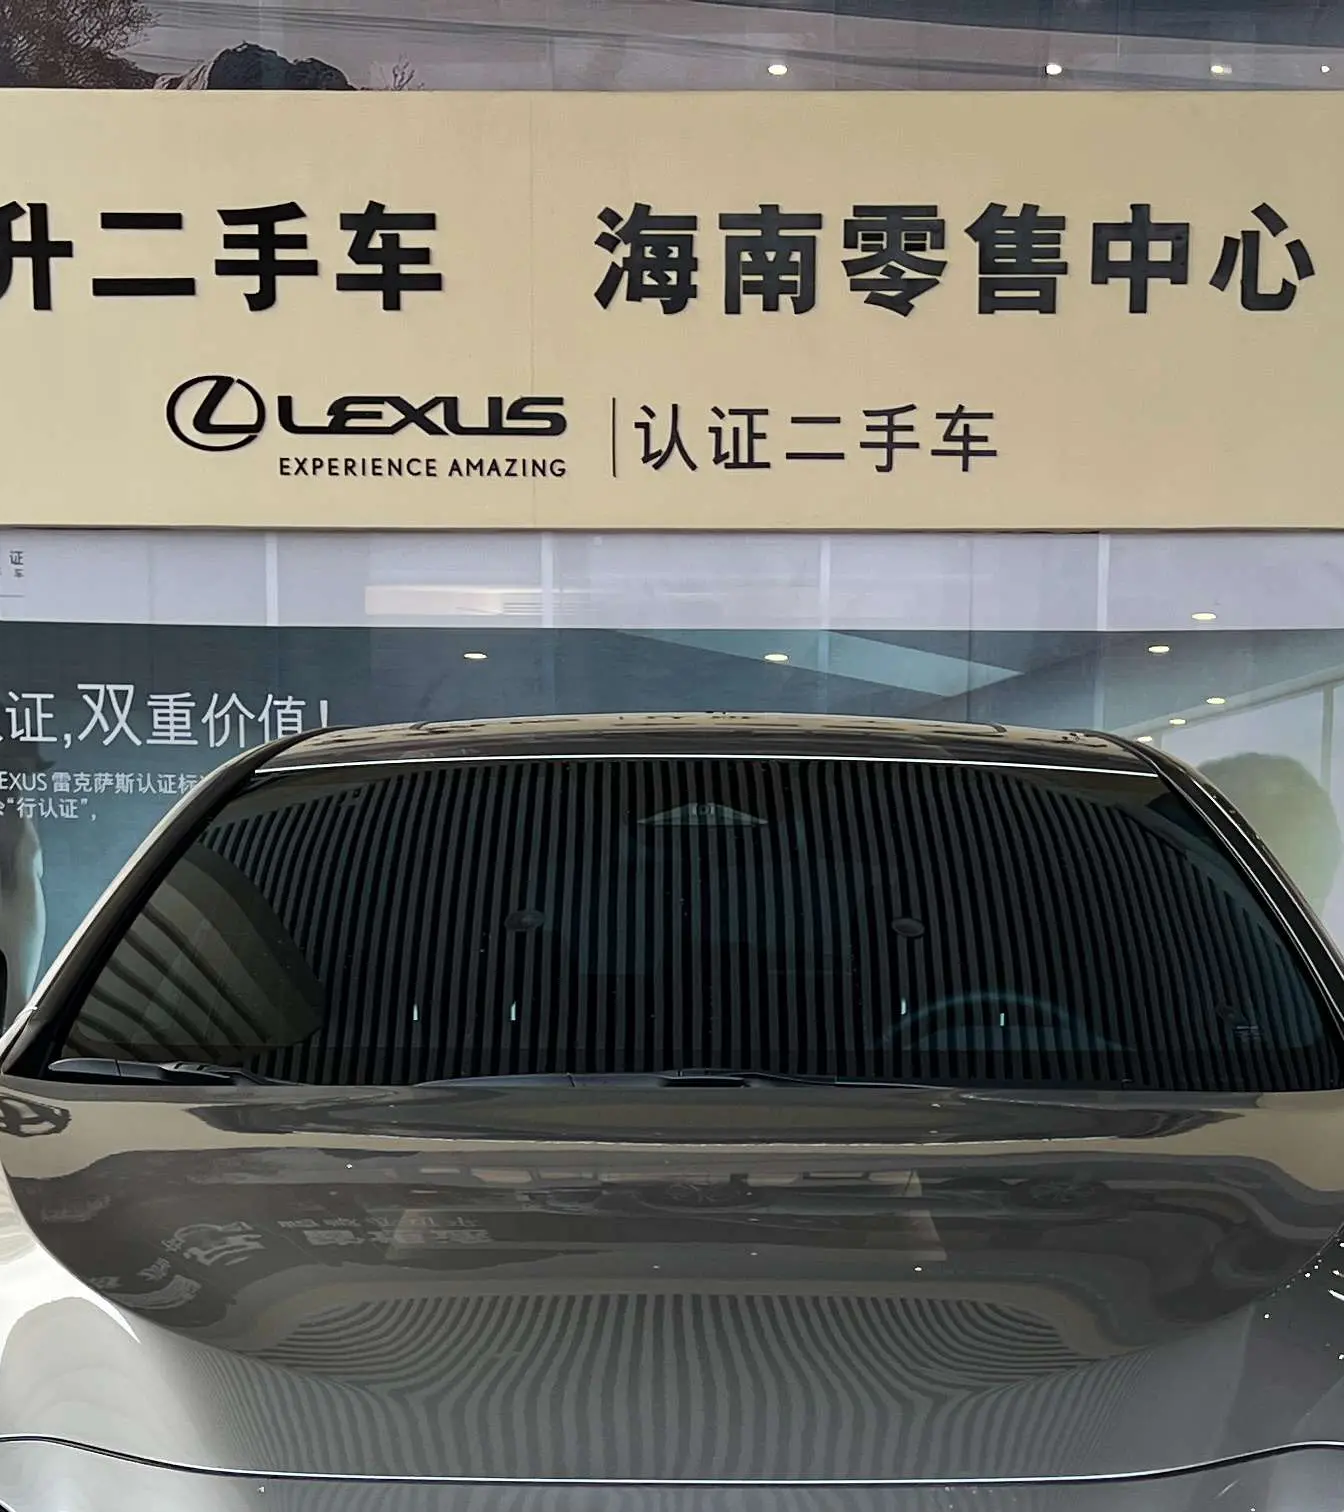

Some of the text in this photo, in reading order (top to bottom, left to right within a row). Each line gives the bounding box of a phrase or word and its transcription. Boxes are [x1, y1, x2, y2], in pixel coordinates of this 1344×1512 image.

[593, 202, 1316, 317] 海南零售中心
[277, 395, 567, 436] LEXUS
[634, 402, 999, 473] 认证二手车
[278, 456, 567, 478] EXPERIENCE AMAZING
[52, 772, 208, 795] 雷克萨斯认证标
